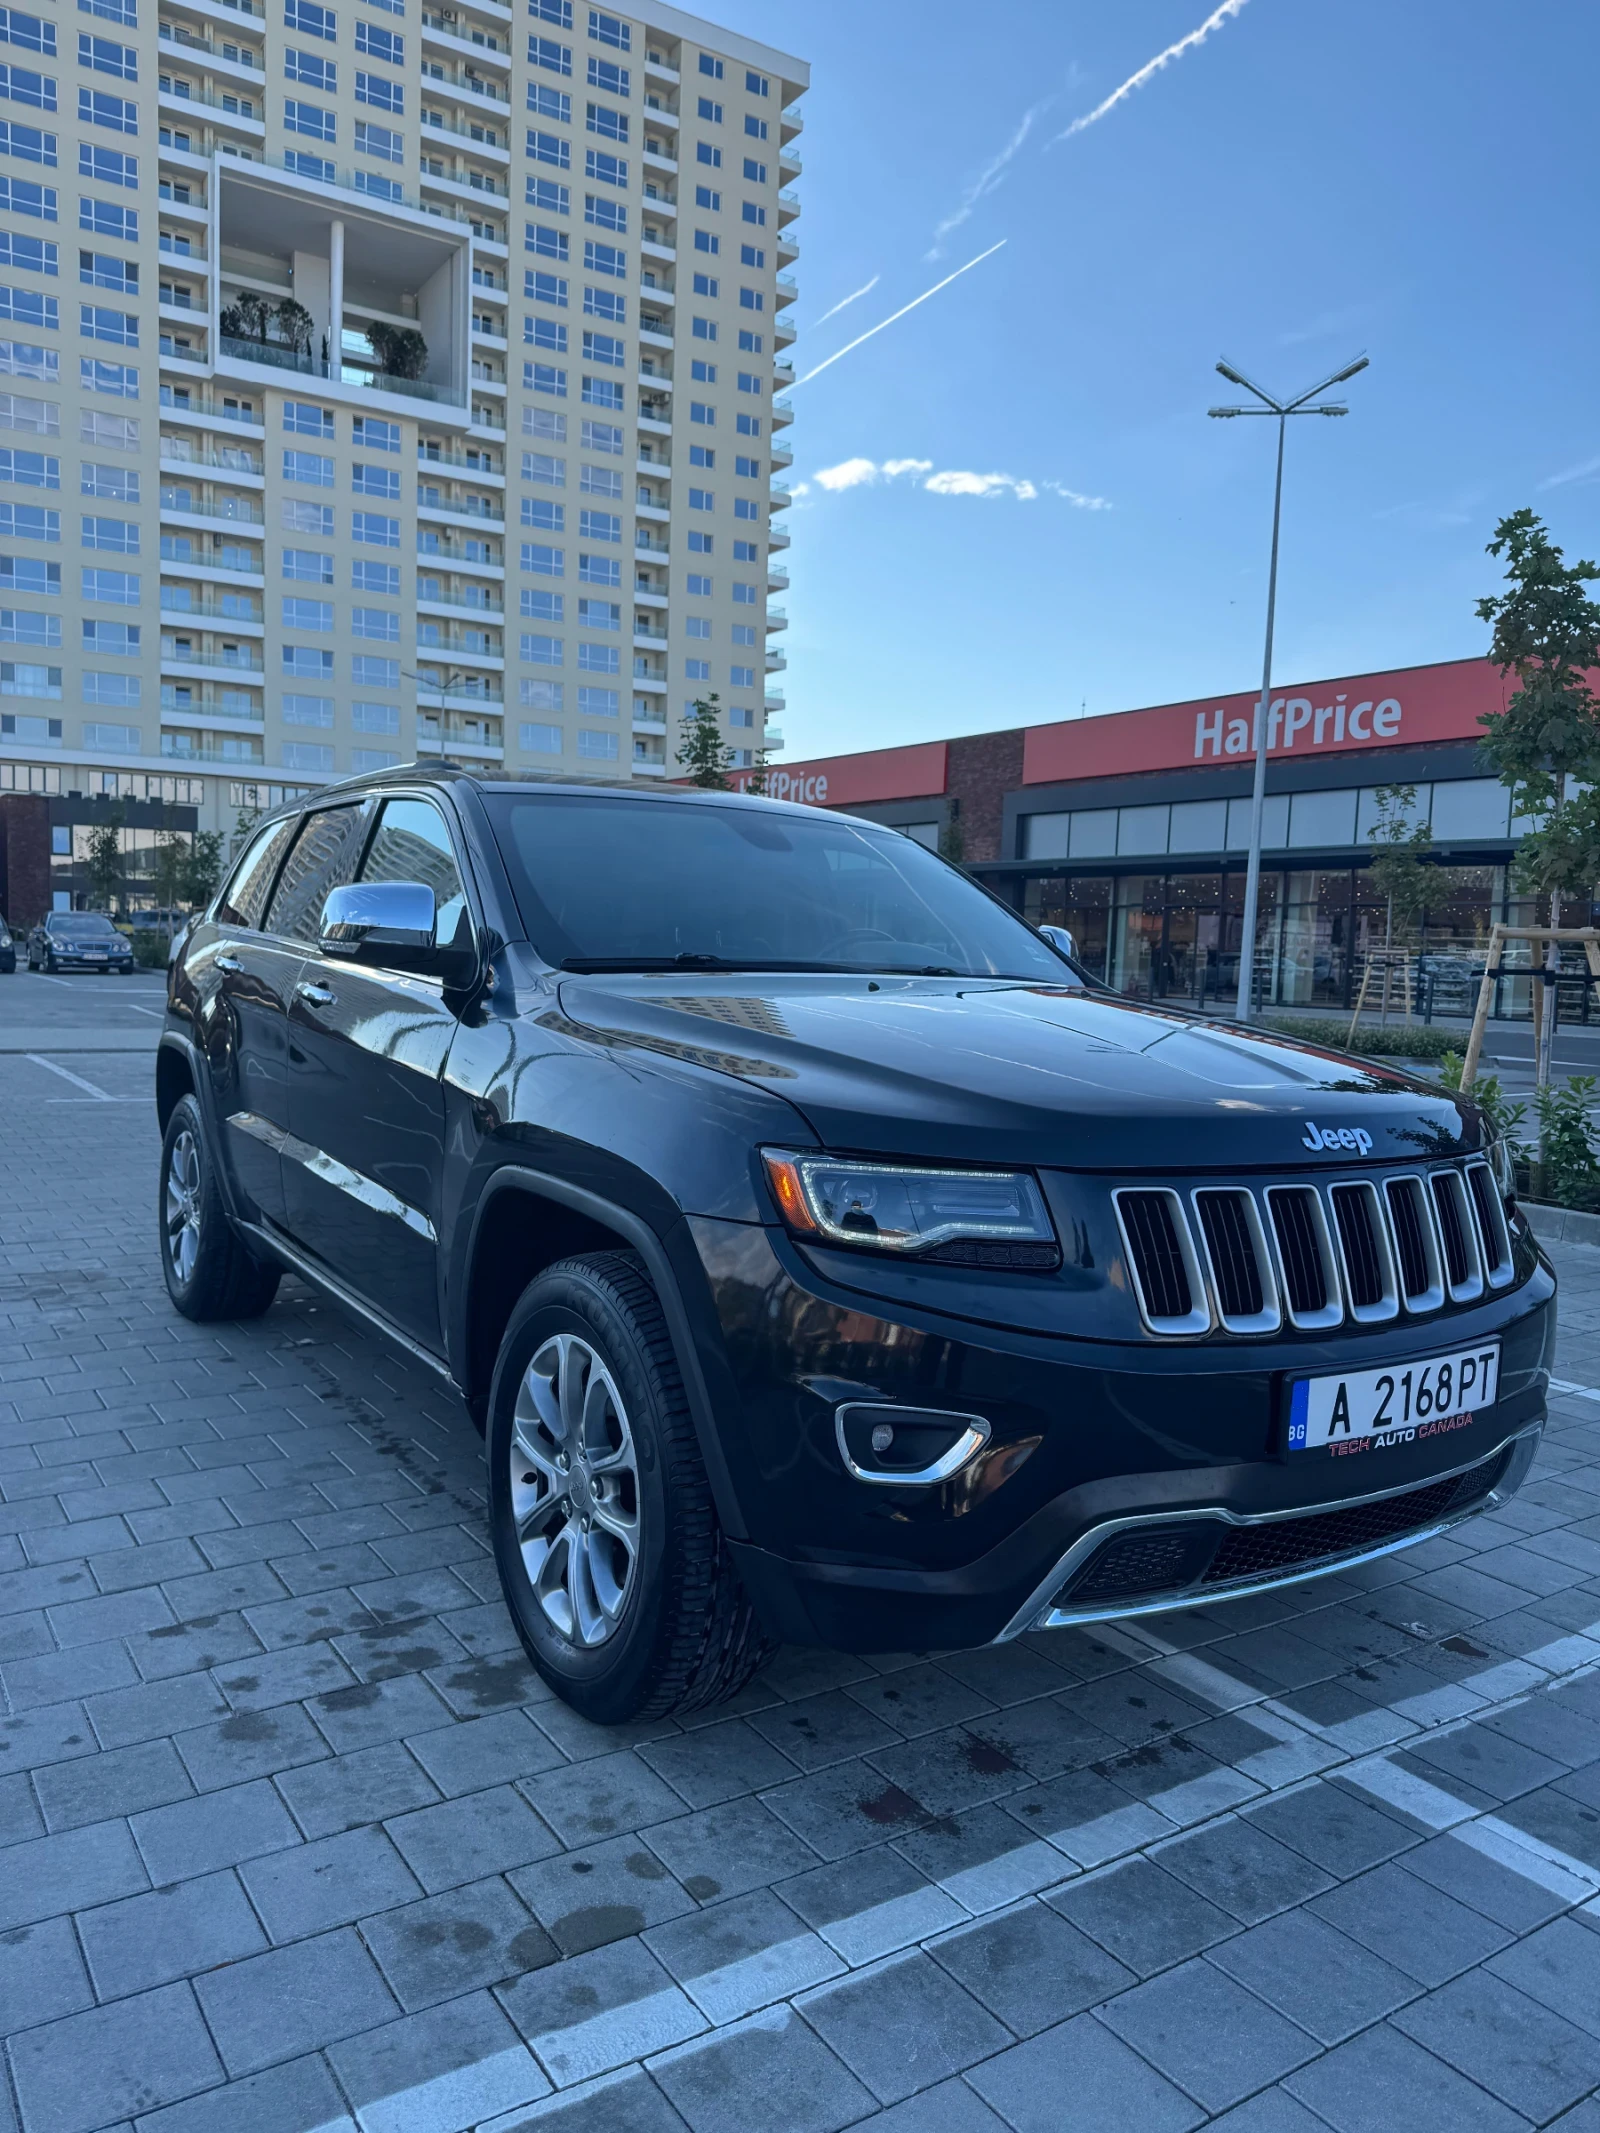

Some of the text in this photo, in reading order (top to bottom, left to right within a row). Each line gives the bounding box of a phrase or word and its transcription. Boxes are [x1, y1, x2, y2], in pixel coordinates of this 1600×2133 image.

[1194, 694, 1402, 758] HalfPrice
[740, 771, 828, 802] HlfPrice
[1301, 1121, 1373, 1157] Jeep
[1327, 1382, 1351, 1437] A
[1288, 1424, 1305, 1441] BG
[1328, 1412, 1473, 1457] TECH AUTO CANADA
